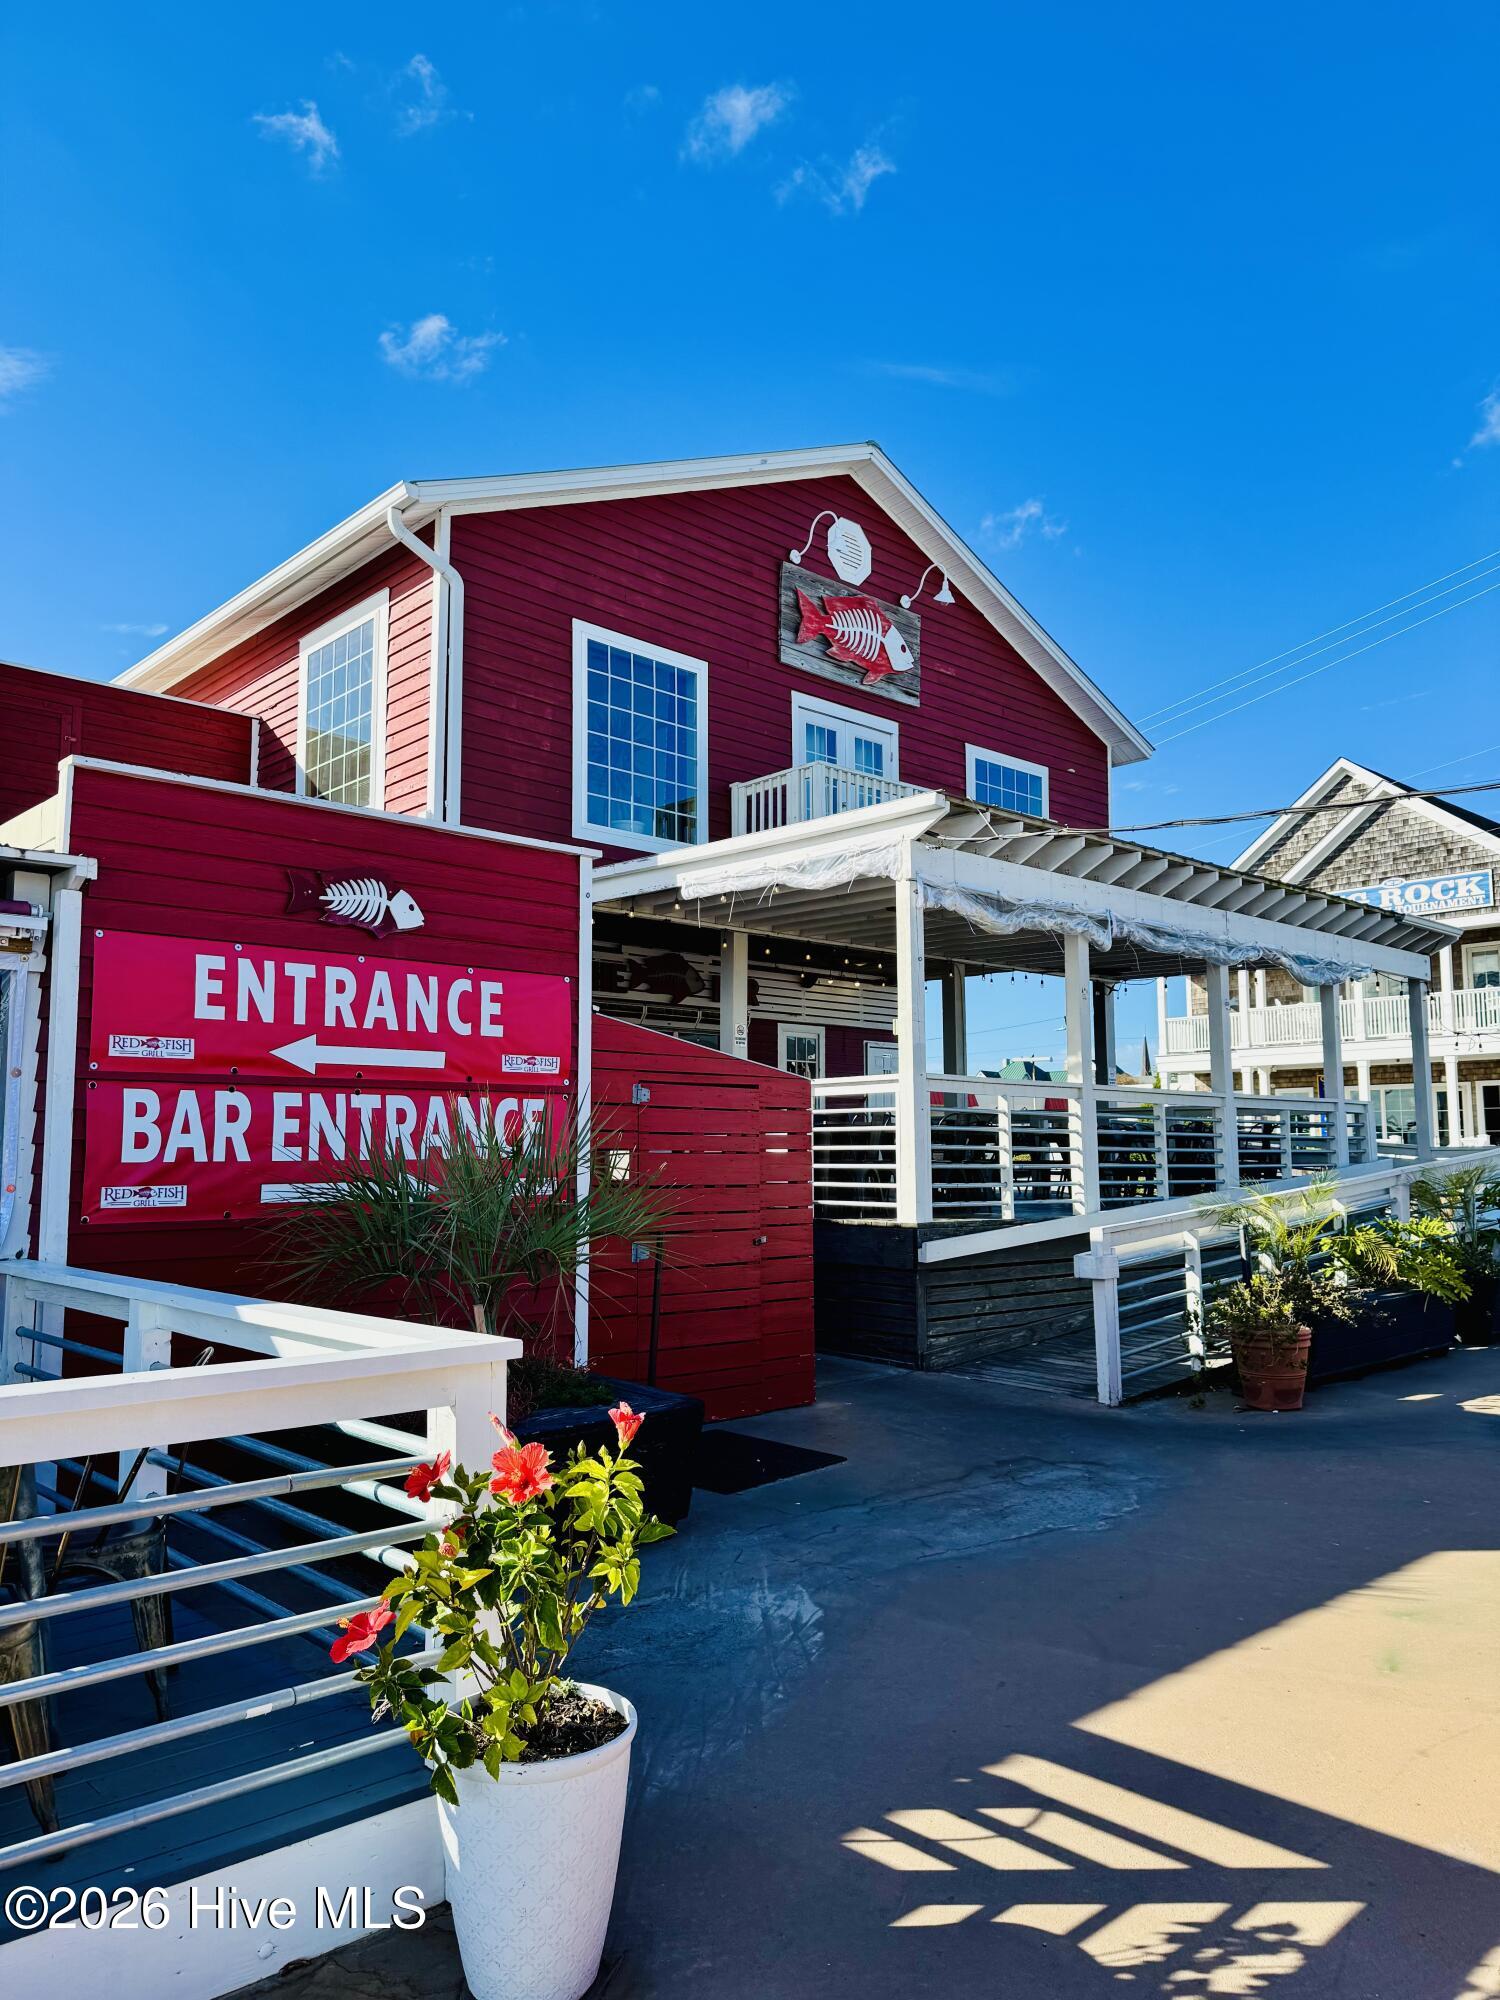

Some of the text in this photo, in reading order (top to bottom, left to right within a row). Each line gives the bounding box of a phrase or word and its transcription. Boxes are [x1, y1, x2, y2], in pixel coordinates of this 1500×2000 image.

[1379, 876, 1486, 908] ROCK
[1395, 895, 1486, 914] TOURNAMENT
[194, 954, 504, 1038] ENTRANCE
[112, 1035, 192, 1052] RED FISH
[504, 1055, 558, 1068] RED FISH
[121, 1087, 252, 1163] BAR
[104, 1186, 184, 1201] RED FISH
